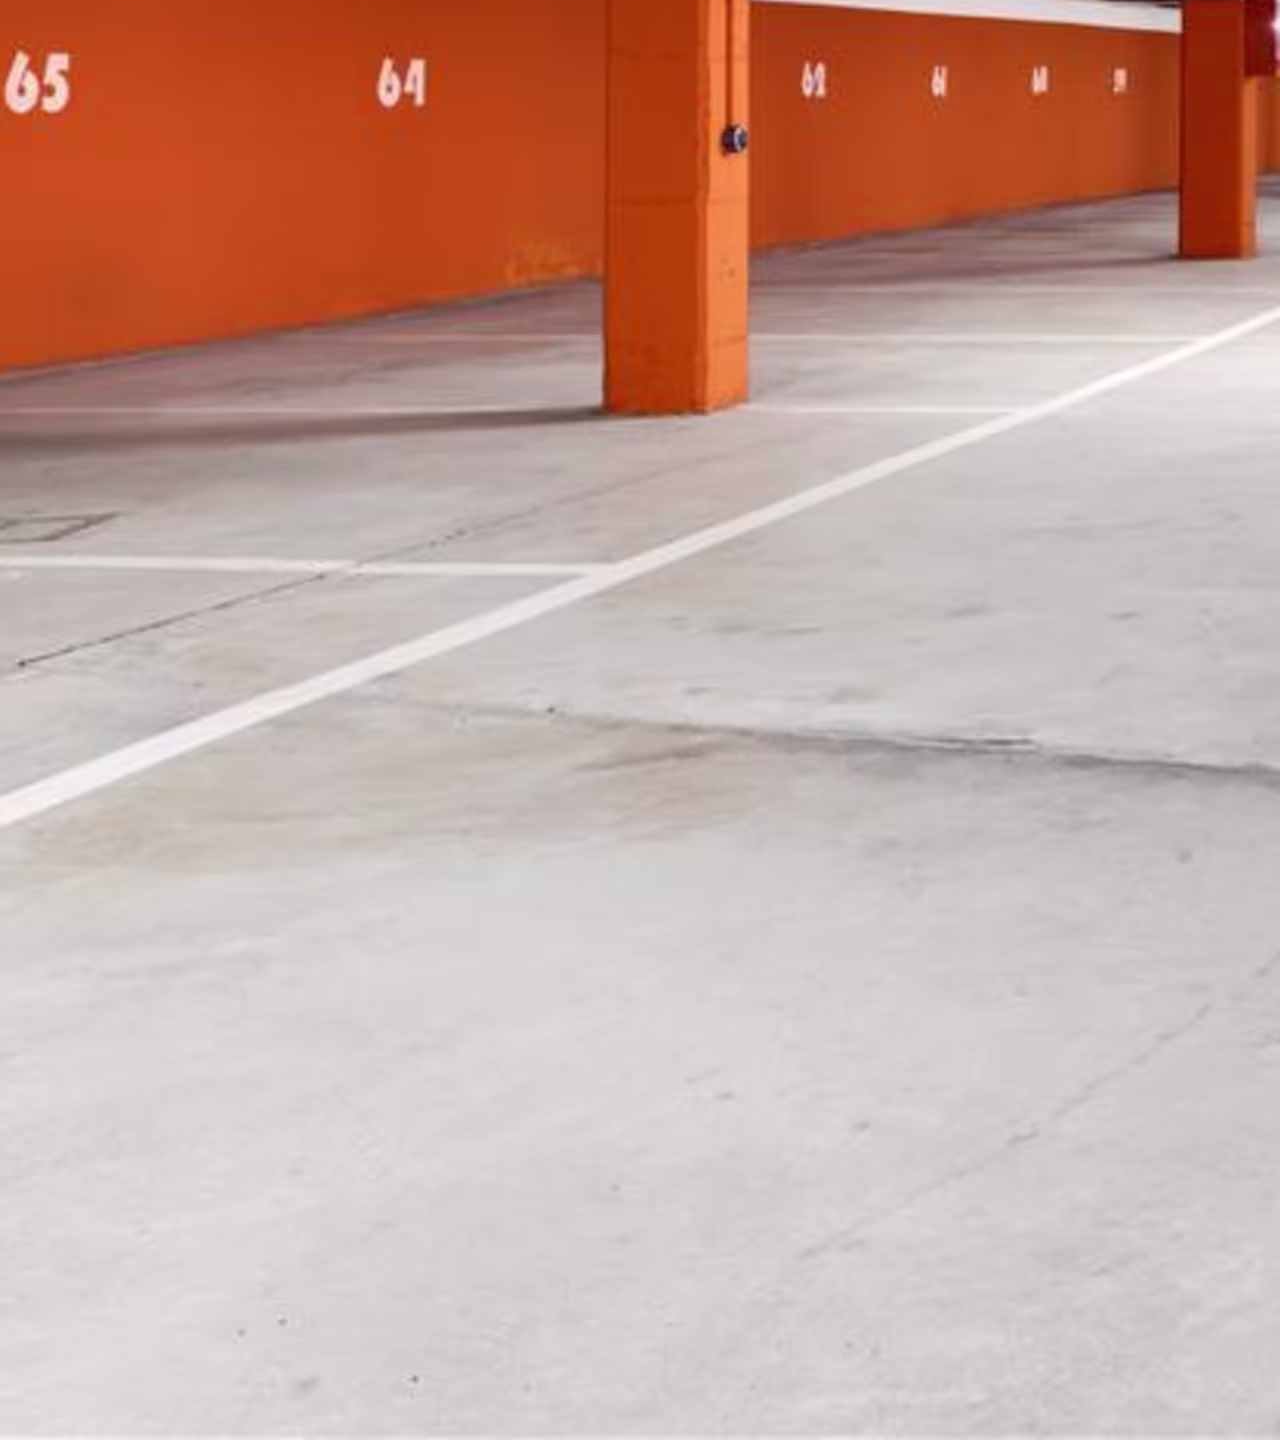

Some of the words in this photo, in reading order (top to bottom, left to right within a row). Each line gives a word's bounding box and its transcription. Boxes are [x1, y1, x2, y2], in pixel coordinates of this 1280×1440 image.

[4, 50, 70, 114] 65
[377, 58, 426, 107] 64
[801, 61, 826, 98] 62
